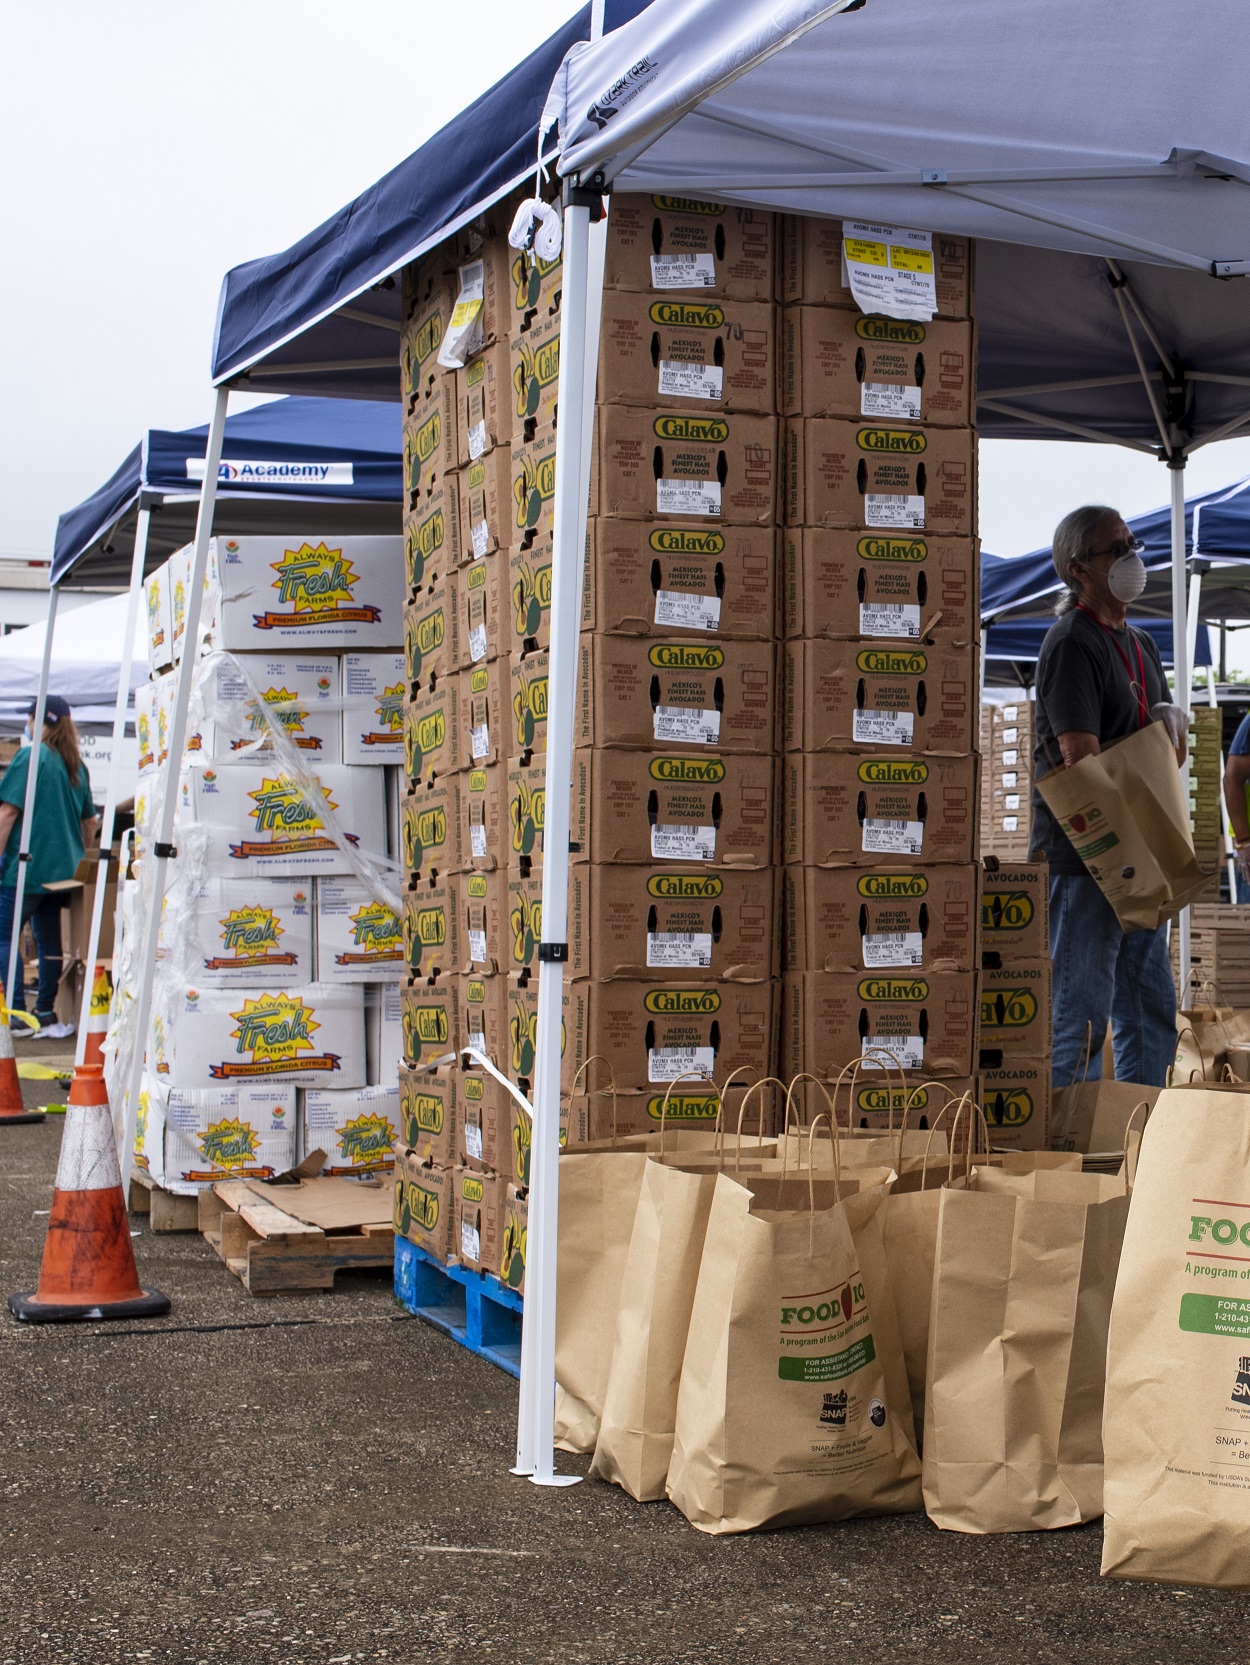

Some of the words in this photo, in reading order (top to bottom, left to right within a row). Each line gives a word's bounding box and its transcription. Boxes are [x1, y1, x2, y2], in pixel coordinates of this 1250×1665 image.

[855, 270, 869, 278] AVOMX
[898, 272, 912, 280] STAGE
[657, 305, 718, 325] Calavo
[725, 322, 743, 341] 70
[863, 320, 919, 341] Calavo
[662, 417, 723, 439] Calavo
[864, 431, 920, 451] Calavo
[241, 464, 329, 480] Academy
[658, 531, 718, 551] Calavo
[865, 539, 922, 559] Calavo
[294, 553, 336, 563] ALWAYS
[278, 560, 349, 603] Fresh
[298, 596, 334, 604] FARMS
[309, 613, 340, 622] FLORIDA
[657, 646, 718, 667] Calavo
[864, 652, 921, 671] Calavo
[658, 759, 719, 780] Calavo
[866, 762, 923, 781] Calavo
[655, 875, 716, 896] Calavo
[866, 875, 922, 895] Calavo
[987, 874, 1039, 883] AVOCADOS
[223, 917, 276, 950] Fresh
[989, 970, 1042, 979] AVOCADOS
[867, 980, 923, 999] Calavo
[253, 1002, 297, 1012] ALWAYS
[653, 990, 714, 1011] Calavo
[237, 1009, 309, 1053] Fresh
[257, 1045, 294, 1054] FARMS
[266, 1063, 299, 1072] FLORIDA
[1185, 1262, 1191, 1273] A
[1193, 1264, 1238, 1279] program
[781, 1299, 841, 1325] FOOD
[853, 1282, 866, 1304] IQ
[1218, 1301, 1238, 1311] FOR
[780, 1337, 785, 1345] A
[786, 1337, 818, 1348] program
[820, 1336, 827, 1344] of
[828, 1334, 837, 1343] the
[821, 1409, 847, 1420] SNAP
[1216, 1436, 1242, 1447] SNAP
[1201, 1471, 1218, 1479] funded
[1219, 1481, 1241, 1489] institution
